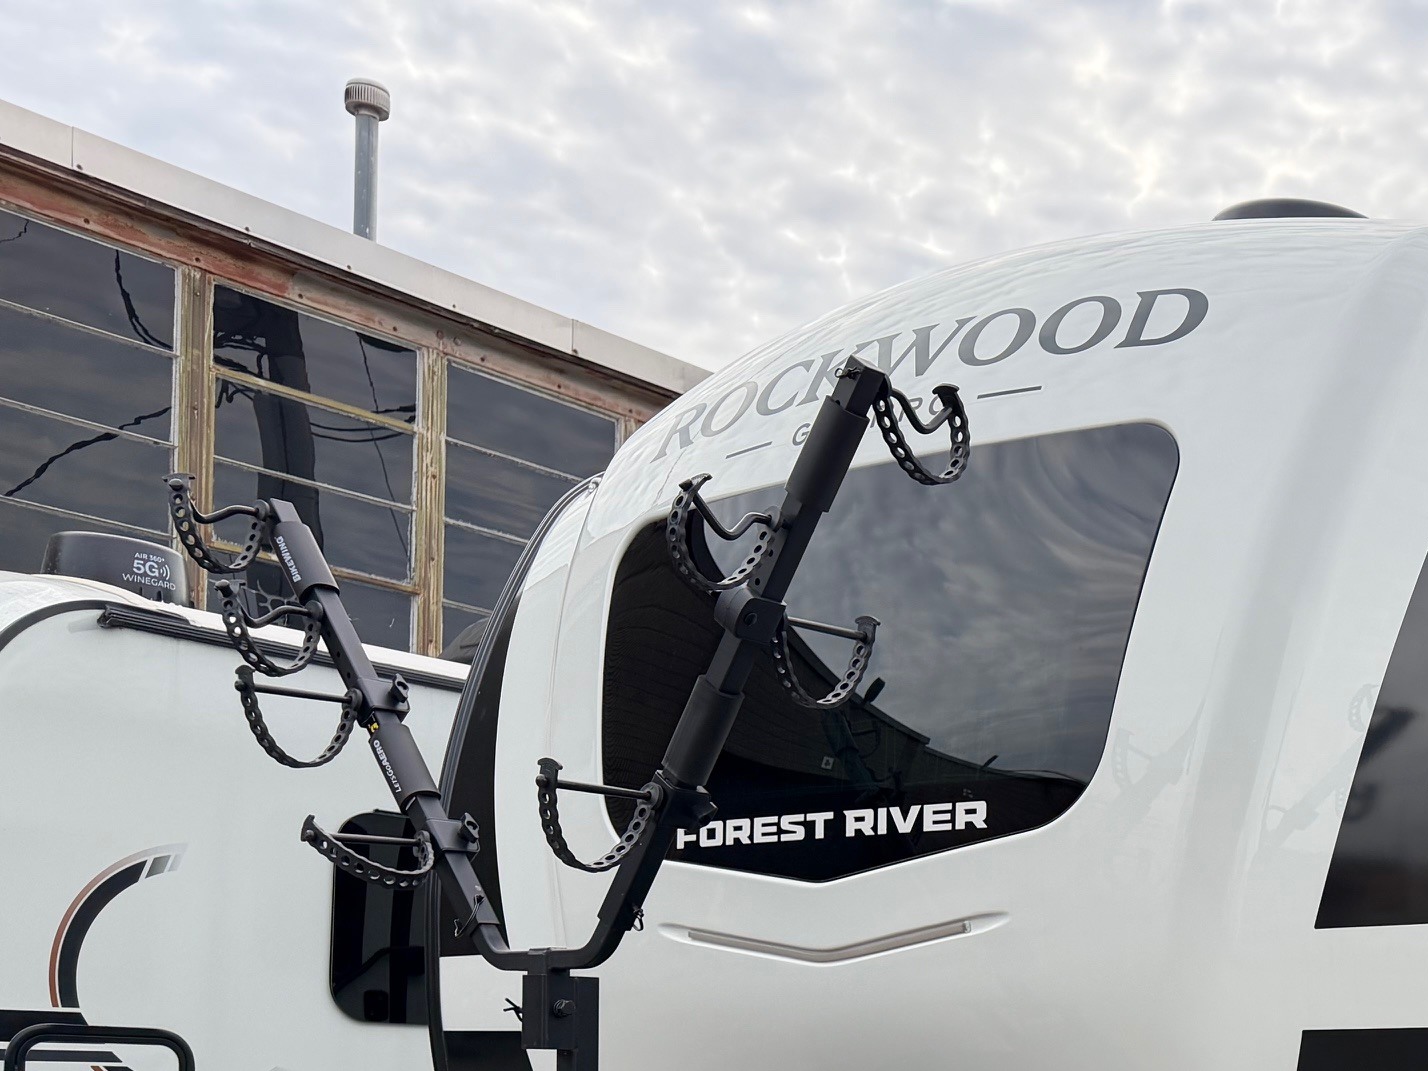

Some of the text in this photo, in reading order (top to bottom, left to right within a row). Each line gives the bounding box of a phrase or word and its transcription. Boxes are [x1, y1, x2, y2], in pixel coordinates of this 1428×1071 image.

[649, 287, 1209, 464] ROCKWOOD
[132, 559, 159, 577] 5G
[134, 552, 148, 560] AIR
[275, 535, 302, 583] BIKEWING
[122, 573, 176, 591] WINEGARD
[676, 799, 988, 850] FOREST RIVER
